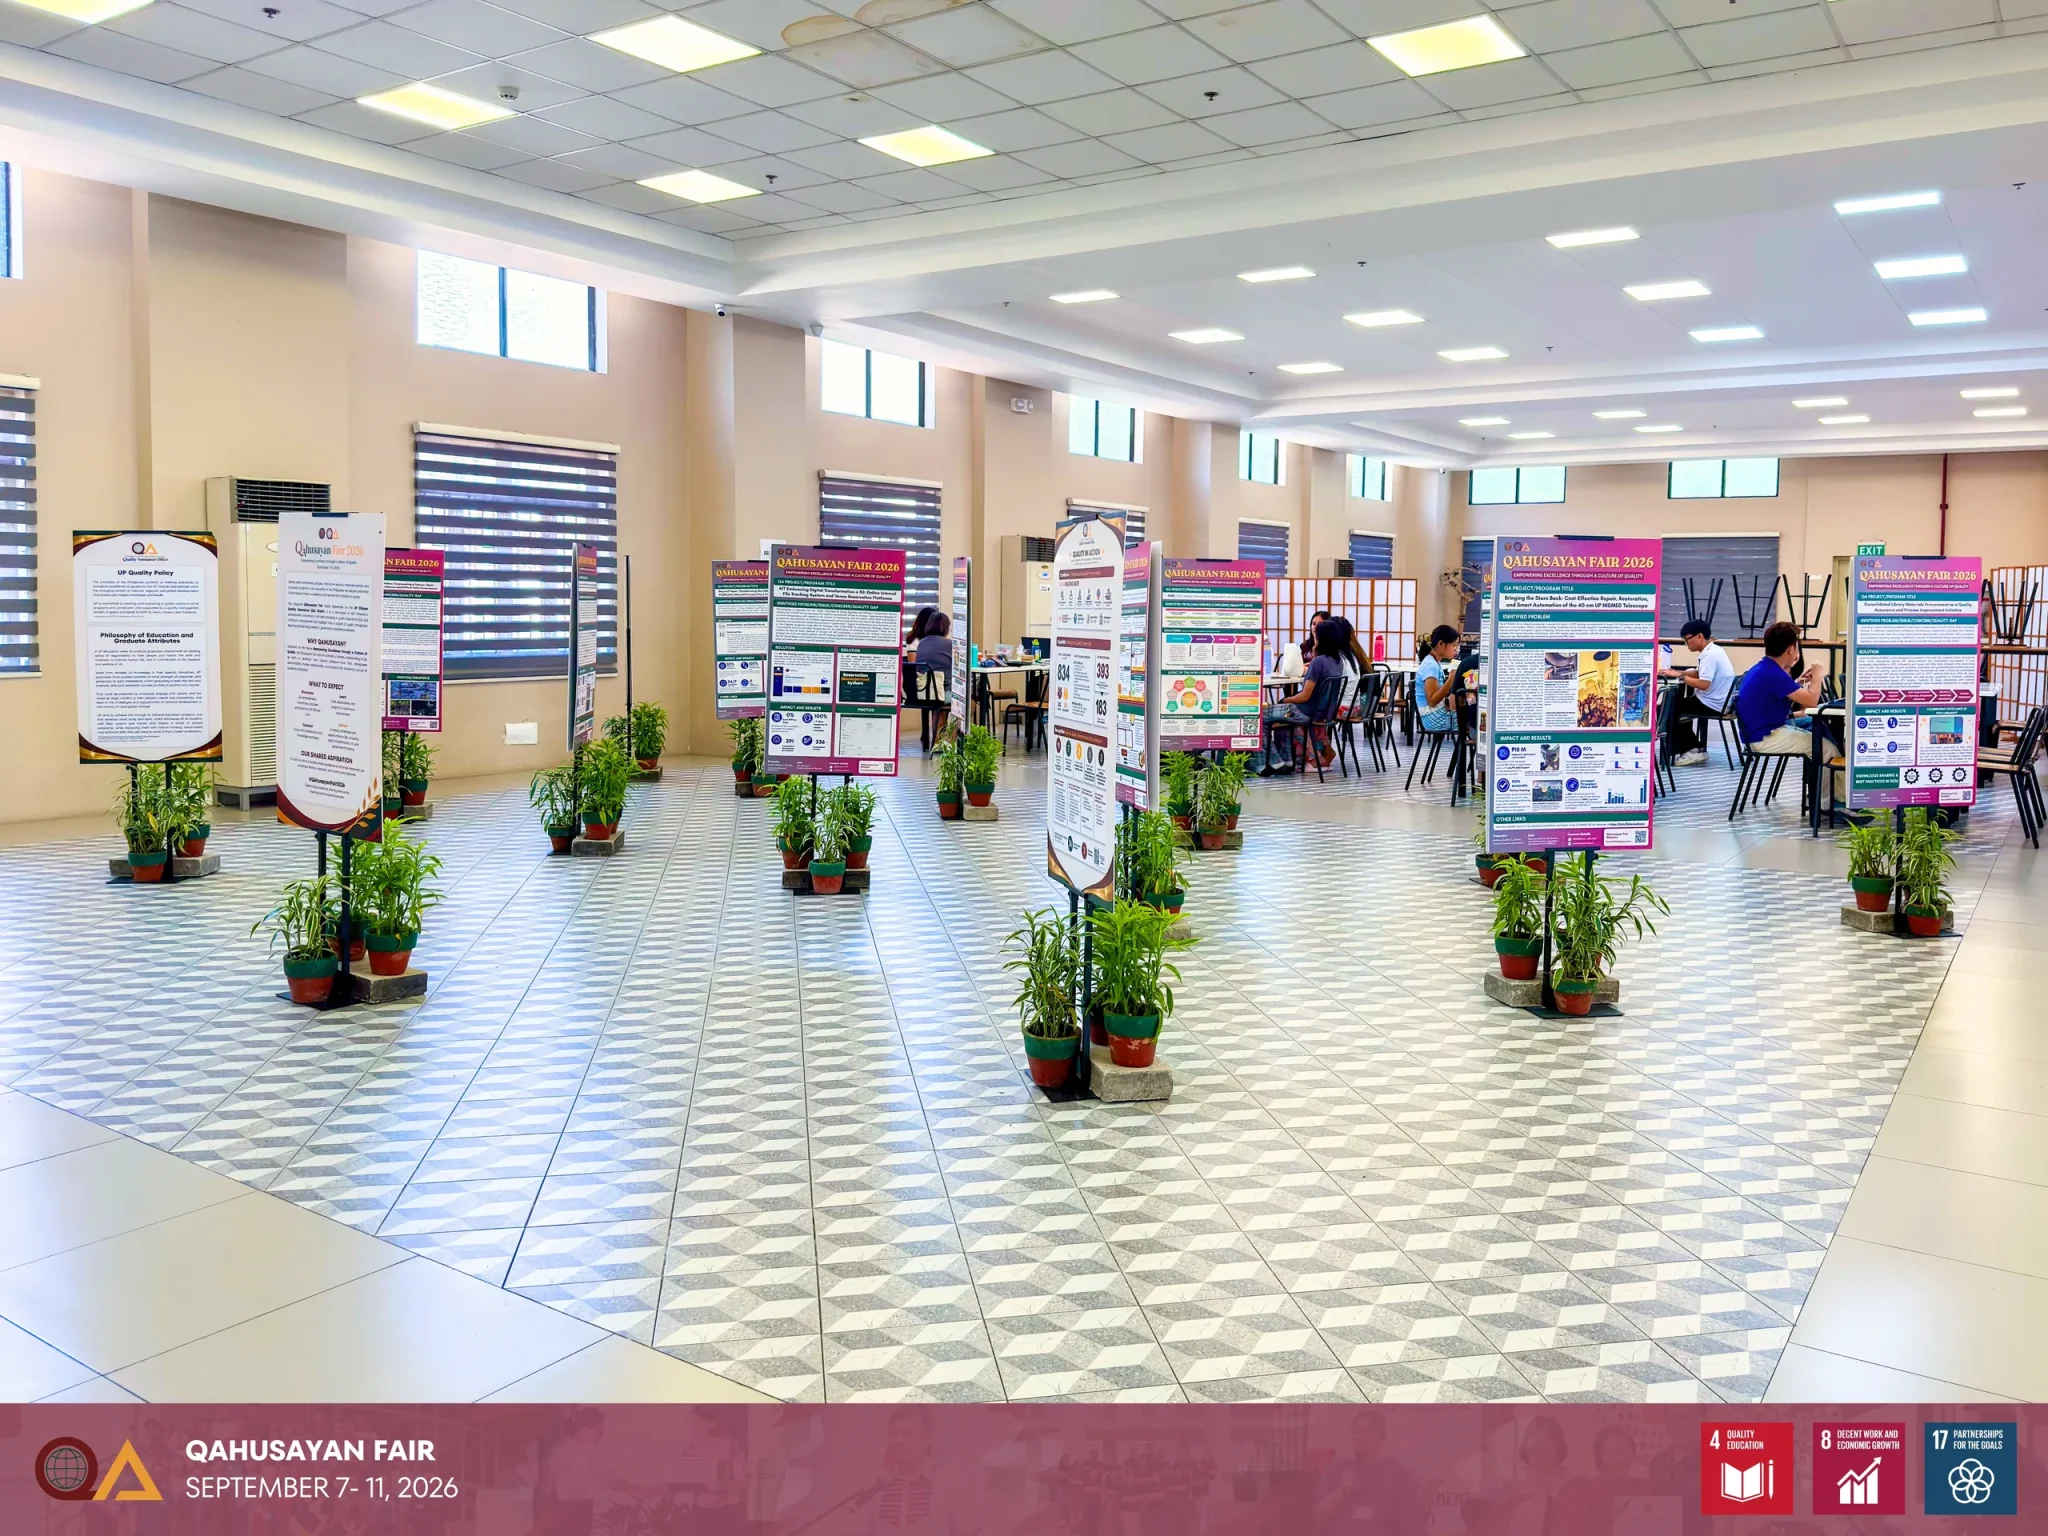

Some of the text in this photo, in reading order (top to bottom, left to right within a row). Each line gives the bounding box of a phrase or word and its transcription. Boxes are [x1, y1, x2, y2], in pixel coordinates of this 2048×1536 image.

[346, 546, 364, 556] 2026
[1860, 546, 1882, 555] EXIT
[776, 558, 899, 571] QAHUSAYAN FAIR 2026
[1503, 555, 1654, 568] QAHUSAYAN FAIR 2026
[1165, 569, 1219, 578] QAHUSAYAN
[1860, 571, 1976, 581] QAHUSAYAN FAIR 2026
[318, 639, 346, 647] QAHUSAYAN?
[1058, 664, 1070, 681] 834
[1097, 663, 1109, 679] 393
[1096, 700, 1107, 716] 183
[328, 755, 353, 764] ASPIRATION
